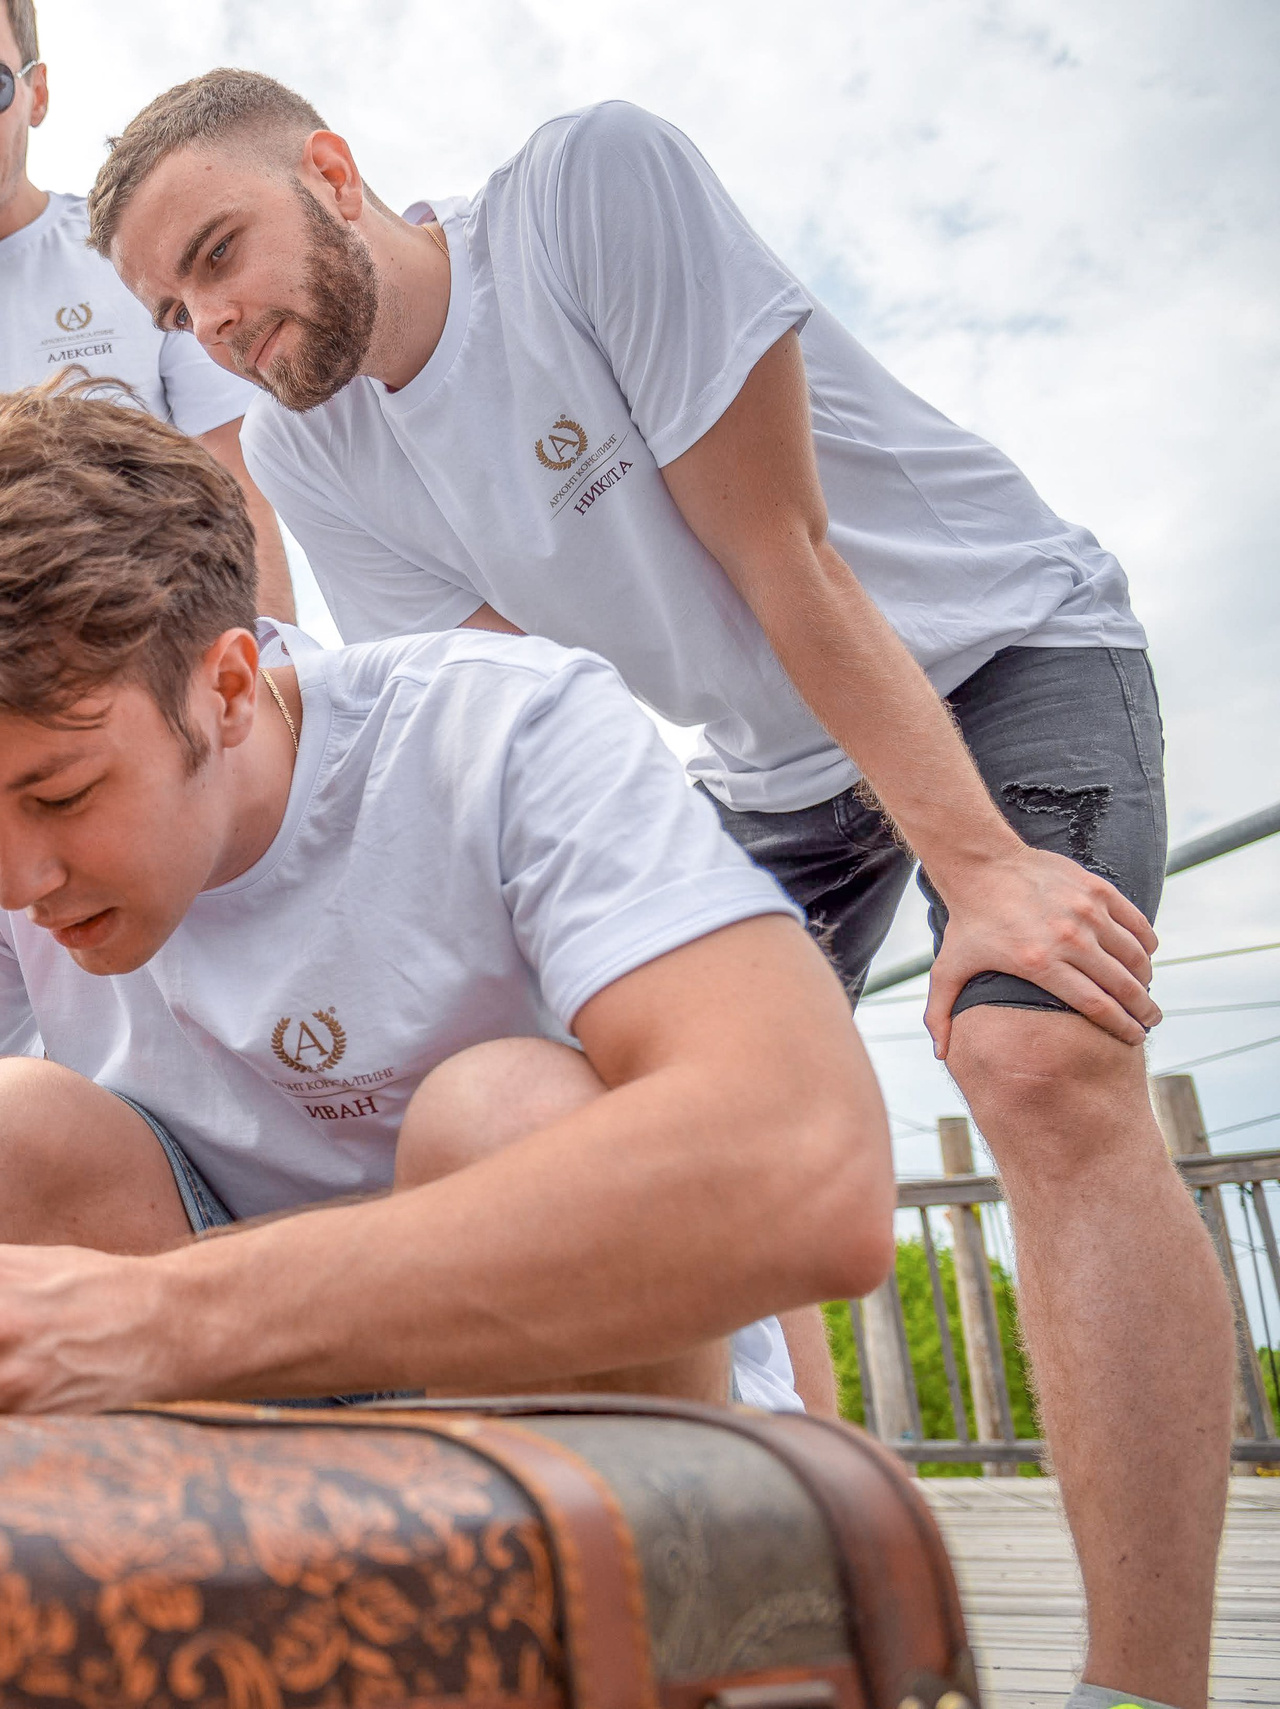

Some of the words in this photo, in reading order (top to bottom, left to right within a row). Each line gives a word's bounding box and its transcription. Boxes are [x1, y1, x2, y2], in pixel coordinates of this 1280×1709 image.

[47, 342, 113, 363] АЛЕКСЕЙ
[549, 475, 578, 508] АРХОНТ
[304, 1096, 379, 1120] ИВАН
